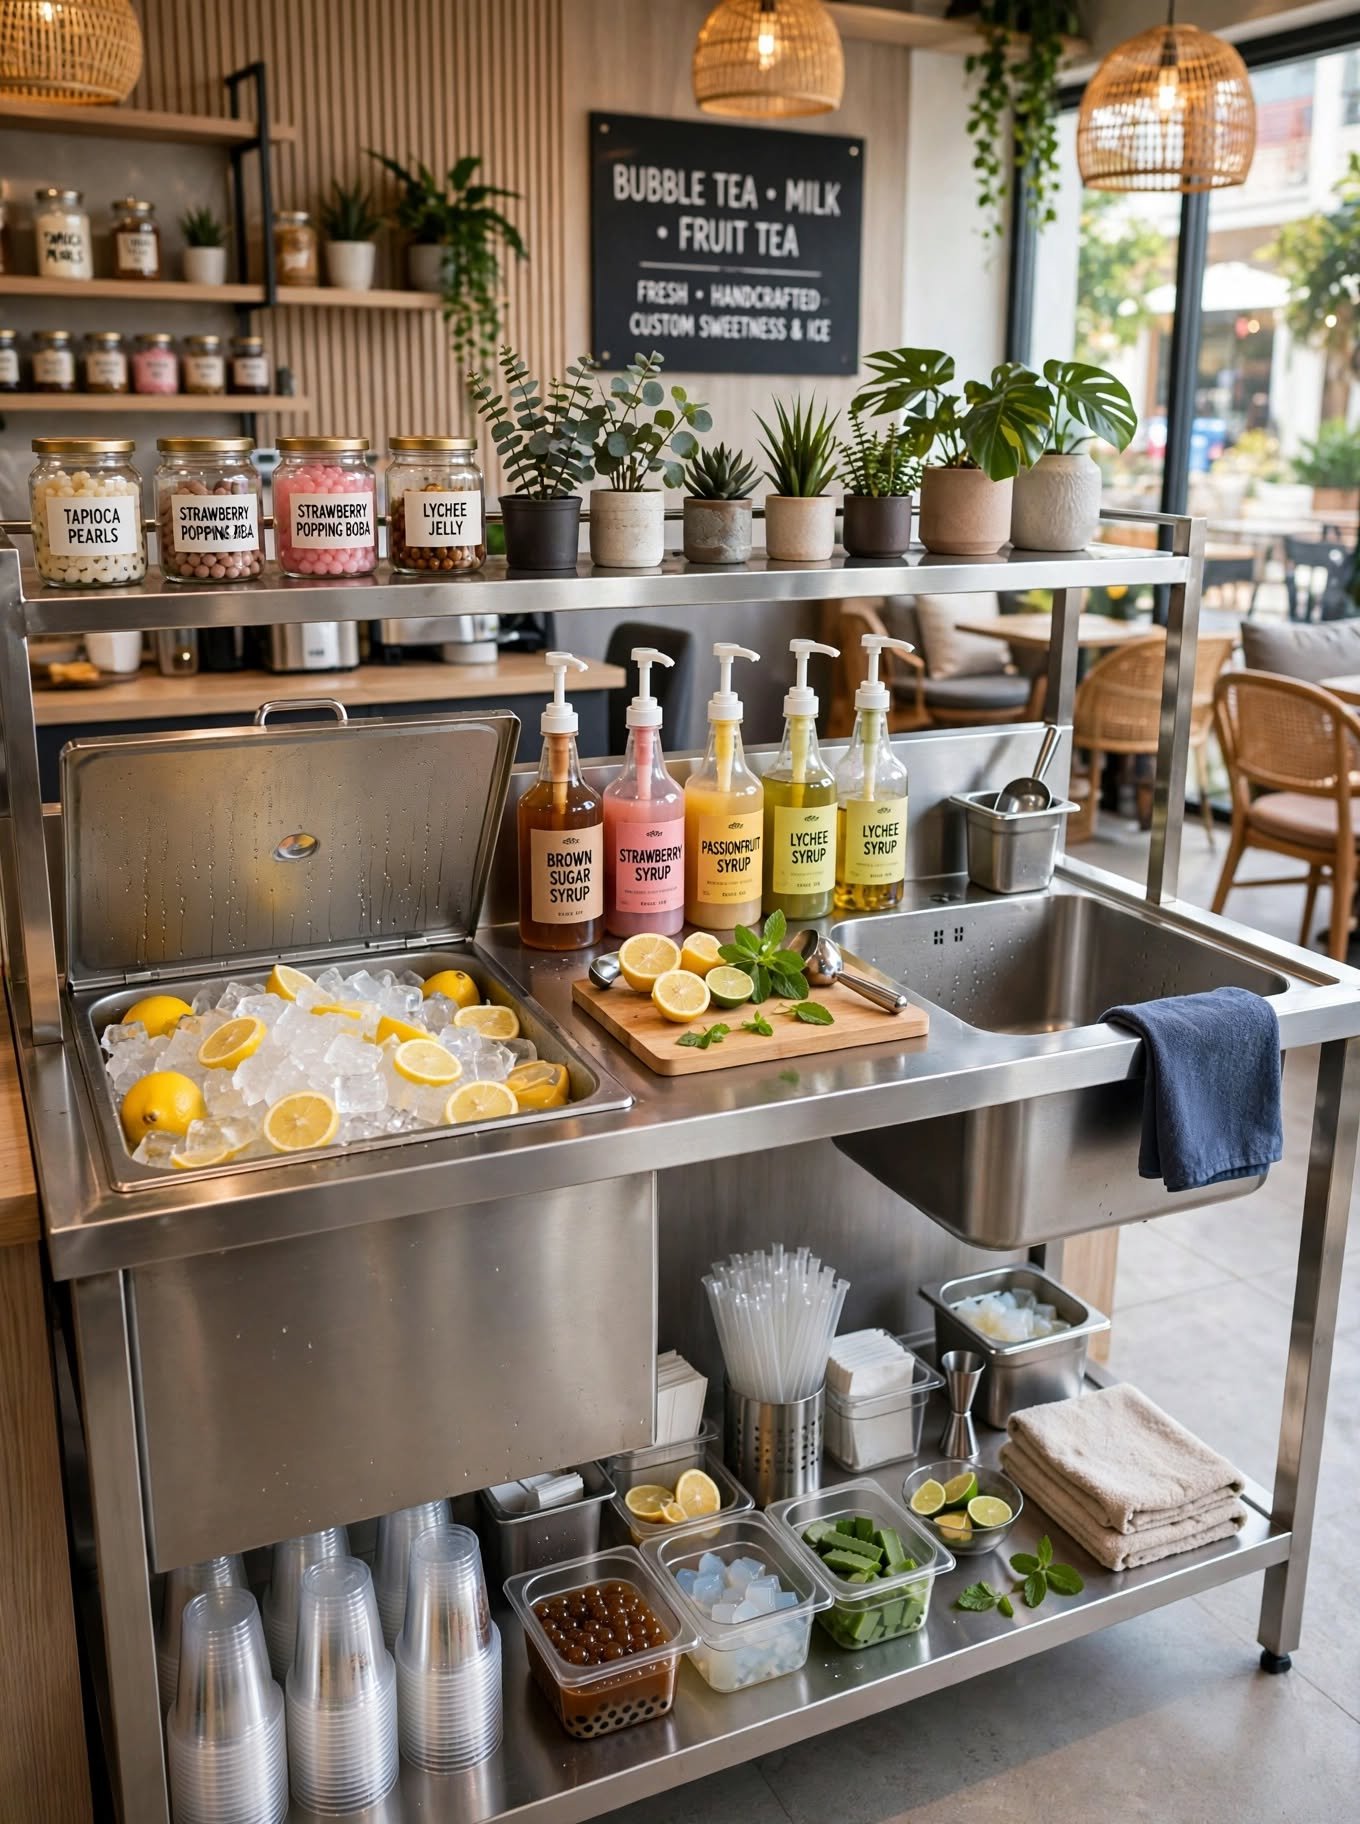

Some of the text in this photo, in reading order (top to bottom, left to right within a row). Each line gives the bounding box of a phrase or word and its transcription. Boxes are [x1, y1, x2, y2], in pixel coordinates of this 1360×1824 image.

[613, 163, 841, 216] BUBBLE TEA MILK
[678, 216, 799, 257] FRUIT TEA
[637, 279, 820, 312] FRESH HANDCRAFTED
[629, 312, 831, 342] CUSTOM SWEETNESS & ICE
[63, 507, 120, 524] TAPIOCA
[179, 506, 249, 521] STRAWBERRY
[297, 503, 367, 519] STRAWBERRY
[423, 502, 467, 518] LYCHEE
[68, 527, 118, 544] PEARLS
[296, 521, 371, 537] POPPING BOBA
[428, 520, 463, 536] JELLY
[790, 830, 829, 847] LYCHEE
[862, 822, 900, 838] LYCHEE
[619, 845, 683, 864] STRAWBERRY
[791, 847, 826, 864] SYRUP
[863, 840, 898, 856] SYRUP
[547, 849, 592, 868] BROWN
[716, 857, 751, 873] SYRUP
[549, 868, 591, 886] SUGAR
[635, 865, 671, 881] SYRUP
[549, 885, 590, 903] SYRUP
